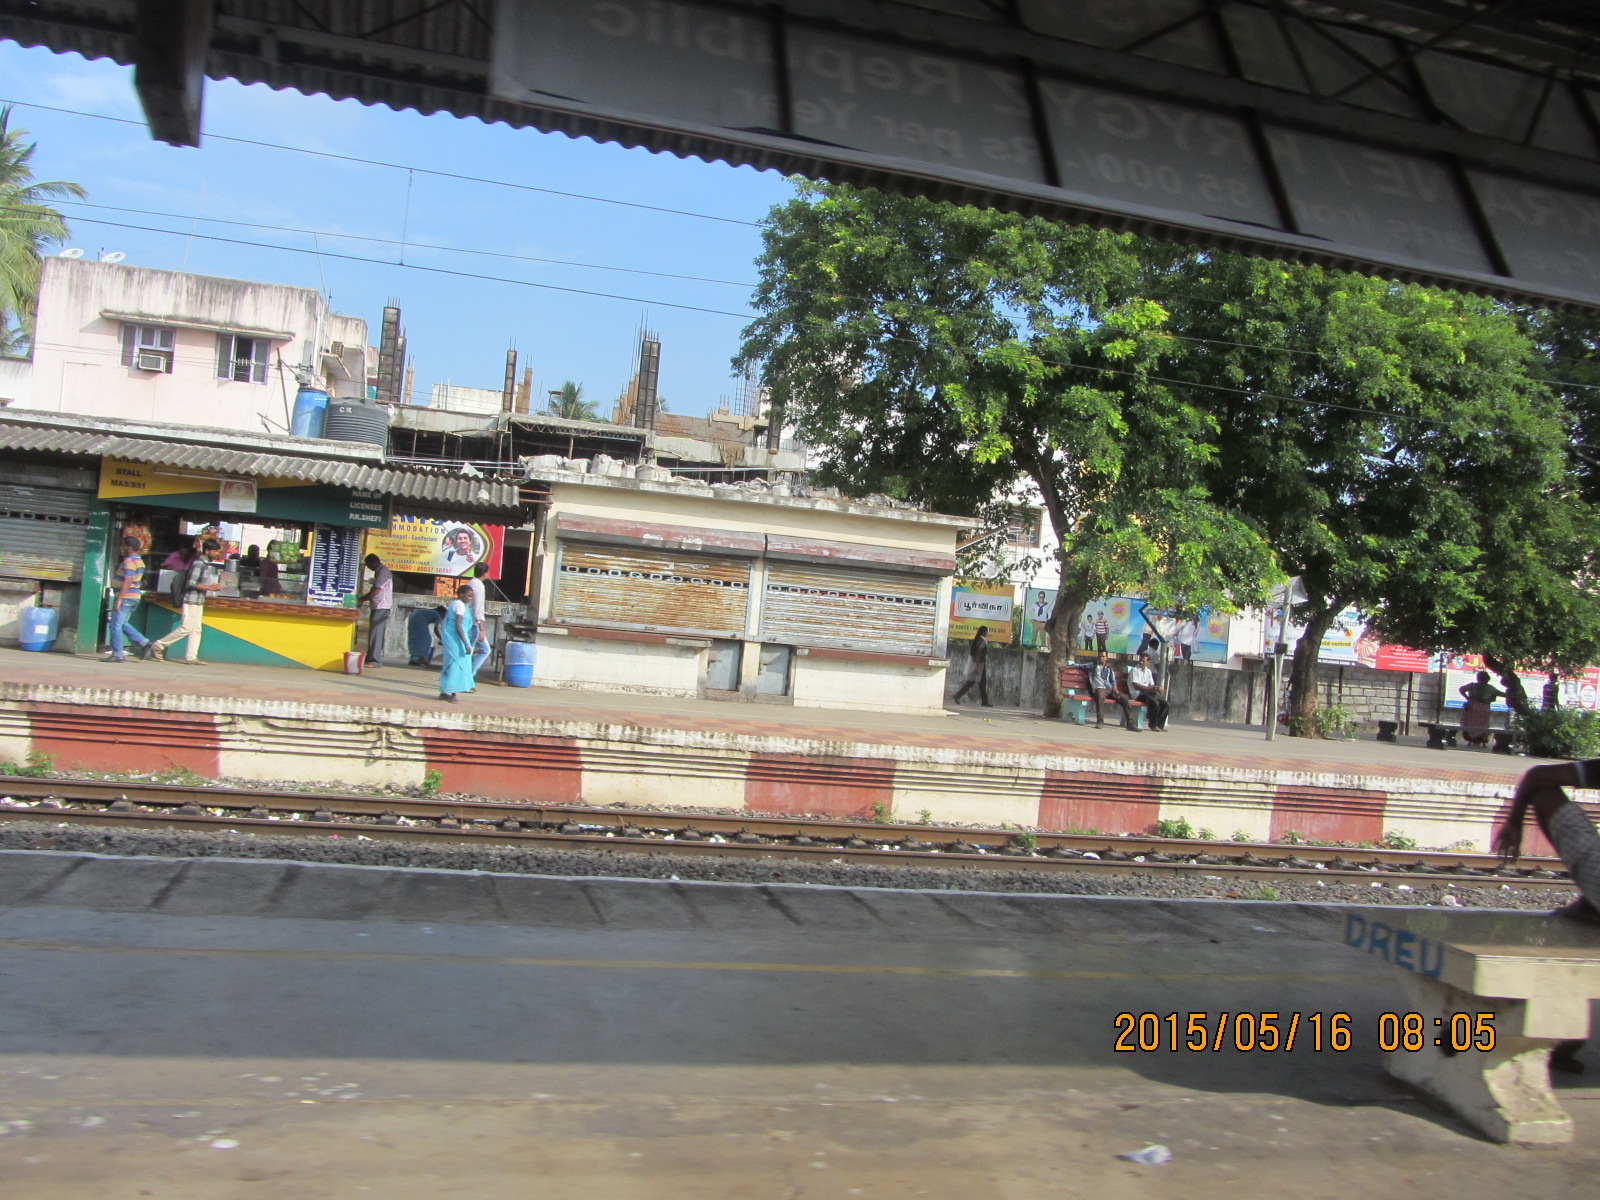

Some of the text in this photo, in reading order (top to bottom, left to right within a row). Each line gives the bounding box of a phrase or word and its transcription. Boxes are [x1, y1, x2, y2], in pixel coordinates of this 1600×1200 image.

[116, 468, 142, 477] STALL
[349, 502, 383, 511] LICENSEE
[391, 523, 447, 535] MMODATION
[963, 600, 1003, 611] பூர்விகா
[1320, 640, 1352, 648] hild-centred
[1343, 913, 1445, 979] DREU
